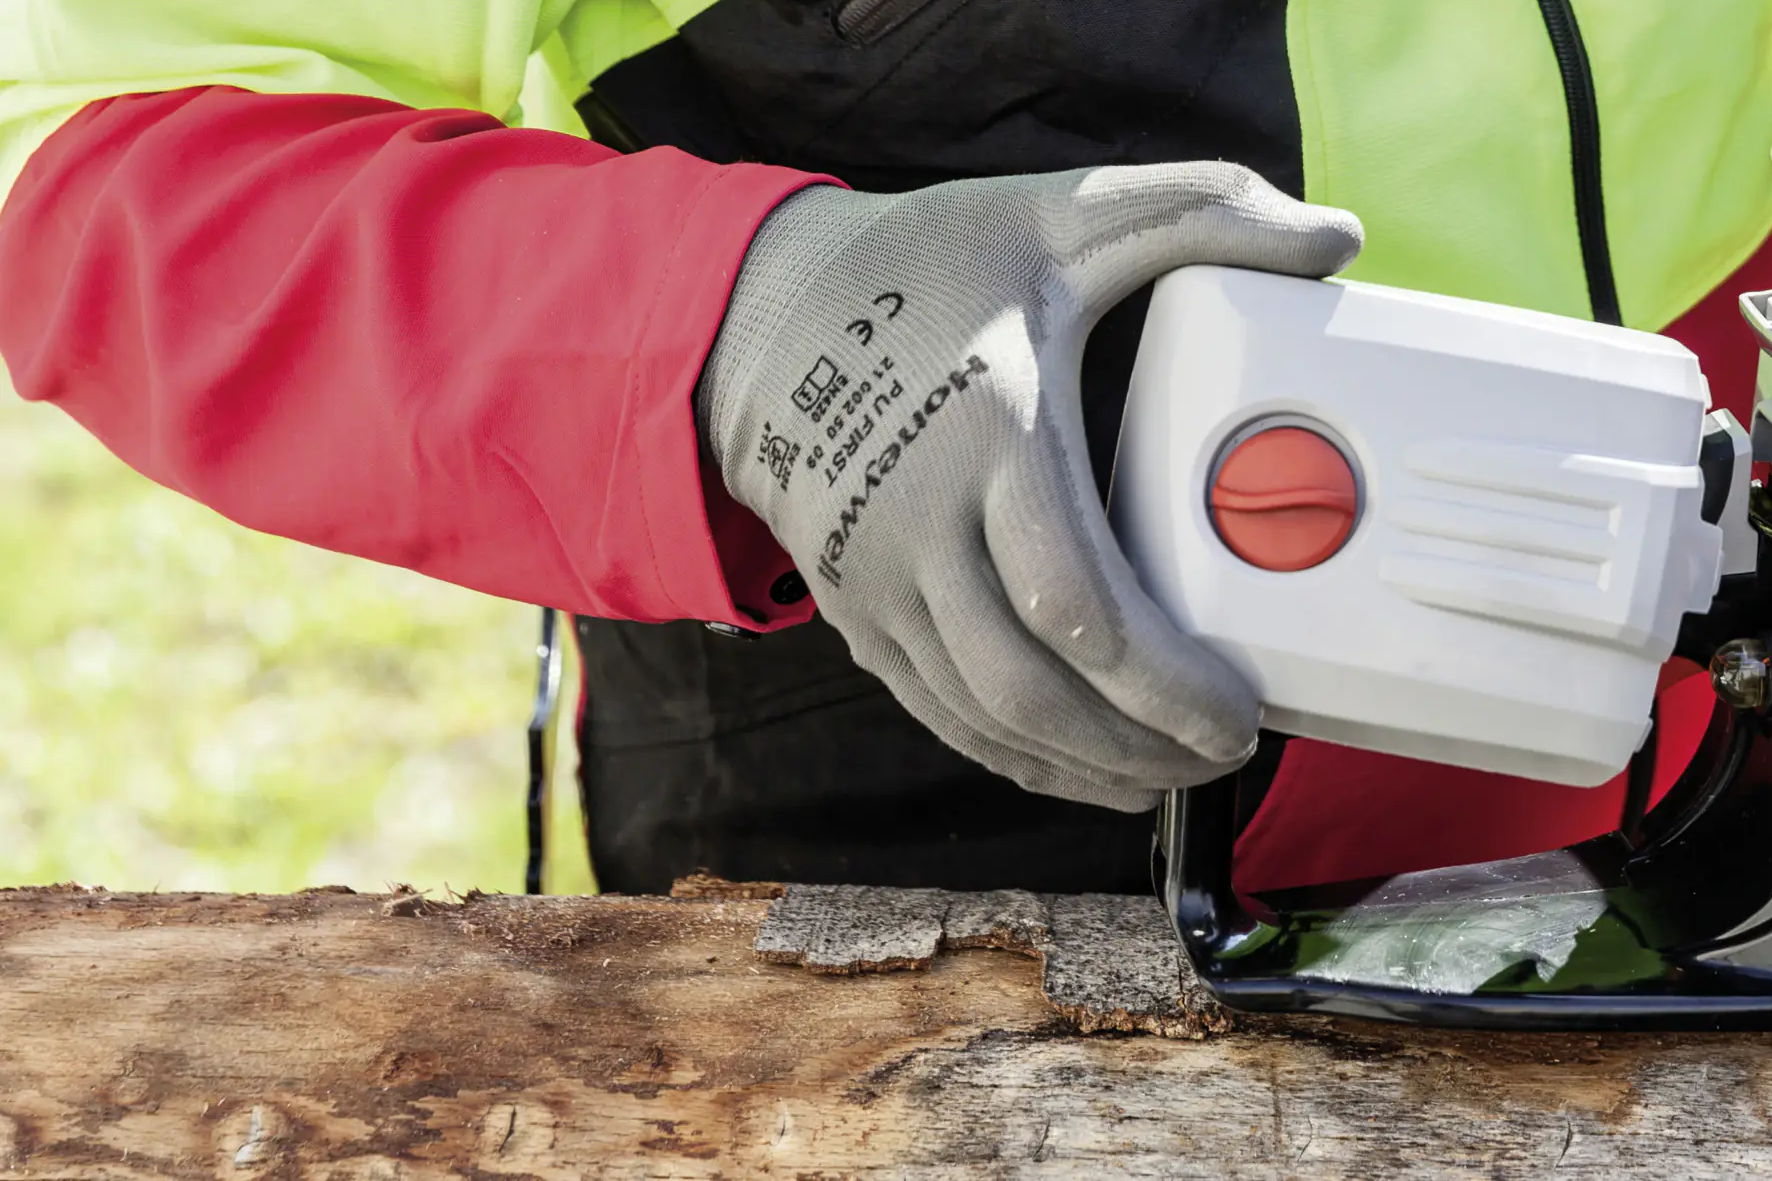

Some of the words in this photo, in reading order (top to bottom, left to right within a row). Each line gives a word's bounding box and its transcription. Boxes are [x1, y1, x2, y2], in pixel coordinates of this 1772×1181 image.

[873, 378, 904, 416] PU
[816, 354, 990, 590] Honeywell
[824, 414, 874, 488] FIRST
